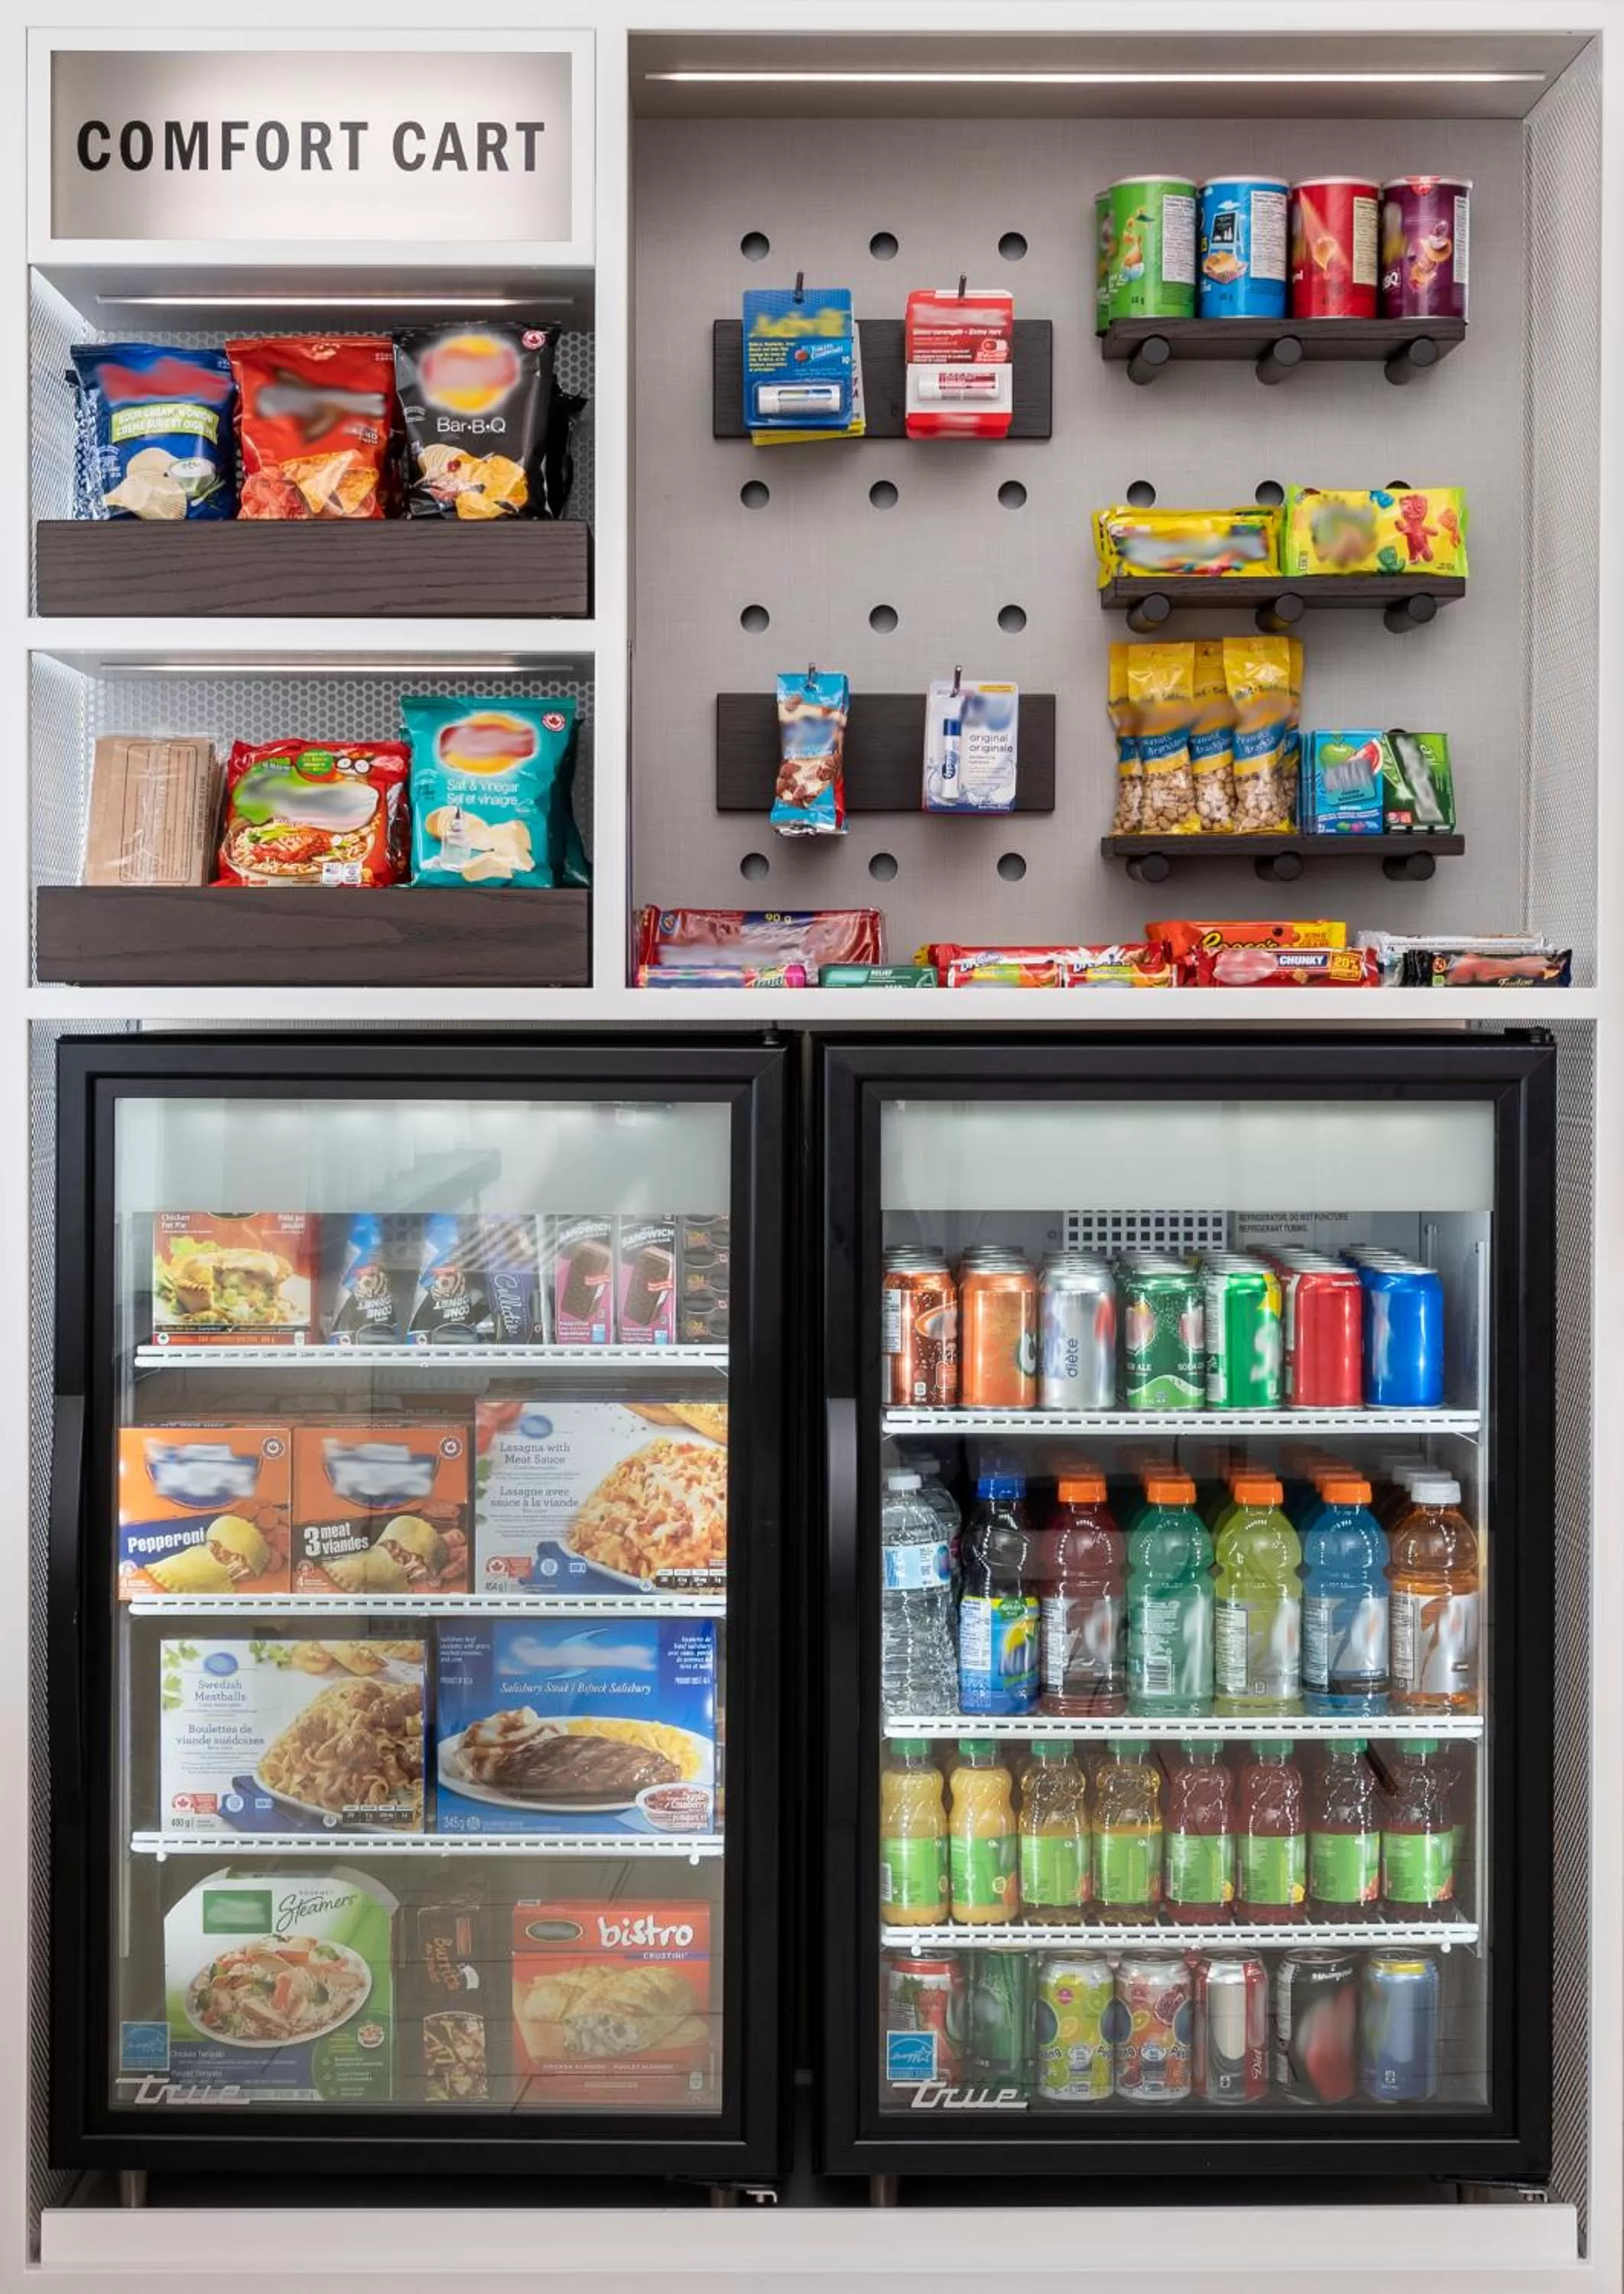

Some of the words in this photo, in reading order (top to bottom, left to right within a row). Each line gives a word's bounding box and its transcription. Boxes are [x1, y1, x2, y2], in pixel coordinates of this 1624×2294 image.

[76, 120, 369, 172] COMFORT
[392, 120, 545, 172] CART
[969, 734, 1008, 742] original
[969, 744, 1013, 753] originale
[447, 779, 466, 791] Salt
[1278, 956, 1324, 966] CHUNKY
[622, 1228, 674, 1249] SANDWICH
[1065, 1338, 1079, 1377] diète
[499, 1442, 544, 1454] Lasagna
[546, 1441, 571, 1452] with
[505, 1454, 531, 1464] Meat
[534, 1454, 566, 1464] Sauce
[499, 1486, 544, 1497] Lasagne
[531, 1497, 542, 1507] la
[544, 1497, 579, 1507] viande
[320, 1521, 351, 1539] meat
[127, 1527, 205, 1554] Pepperoni
[304, 1526, 320, 1556] 3
[322, 1536, 369, 1555] viandes
[198, 1679, 242, 1689] Swedish
[609, 1682, 653, 1695] Salisbury
[195, 1691, 246, 1701] Meatballs
[189, 1724, 237, 1733] Boulettes
[239, 1724, 253, 1733] de
[176, 1734, 211, 1744] viande
[214, 1734, 265, 1744] suédoises
[276, 1893, 359, 1933] Steamers
[597, 1913, 694, 1948] bistro
[116, 2074, 251, 2104] True
[892, 2080, 1028, 2109] True
